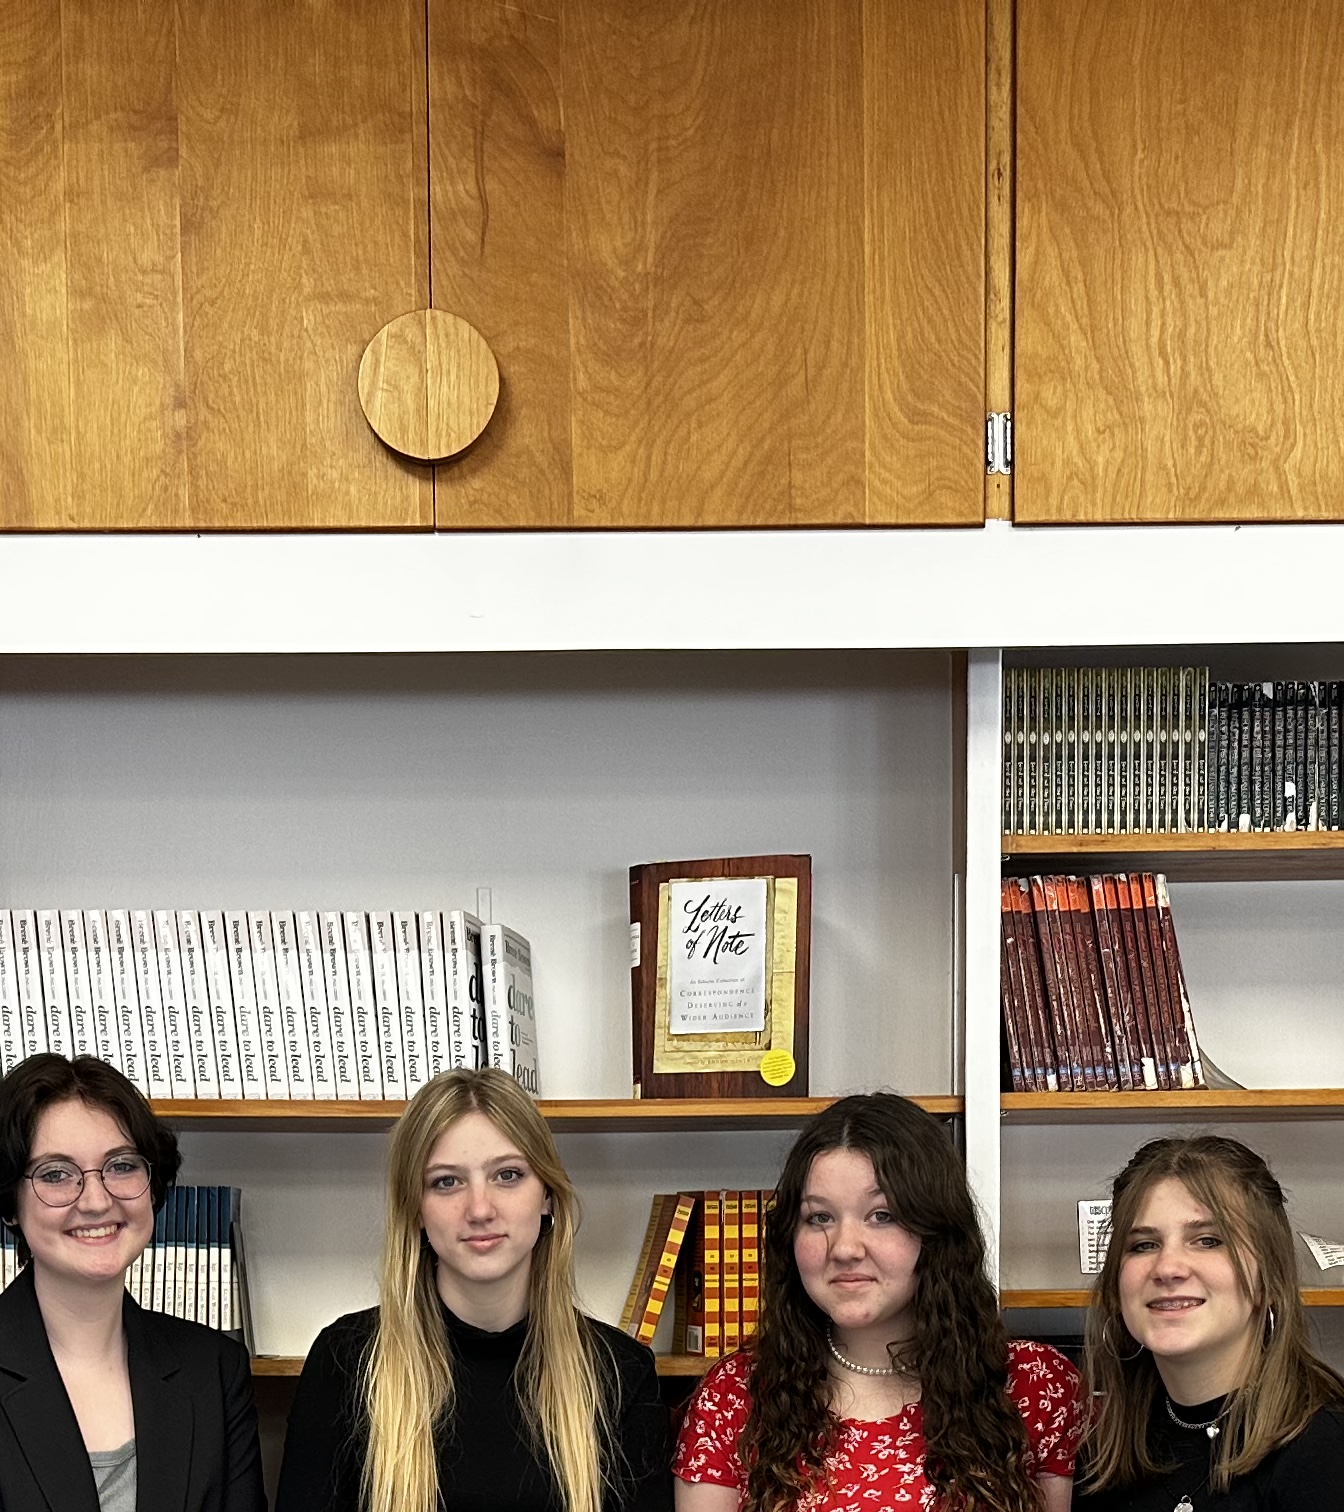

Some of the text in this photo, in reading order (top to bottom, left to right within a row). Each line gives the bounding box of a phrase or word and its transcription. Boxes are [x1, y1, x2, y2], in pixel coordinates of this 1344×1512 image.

[683, 895, 745, 933] Letters
[685, 926, 755, 964] of Note
[508, 974, 534, 1021] dare
[509, 1015, 520, 1047] to
[121, 1005, 139, 1083] dare to lead
[145, 1005, 164, 1083] dare to lead
[168, 1005, 187, 1083] dare to lead
[192, 1006, 210, 1082] dare to lead
[263, 1006, 281, 1082] dare to lead
[310, 1006, 327, 1083] dare to lead
[333, 1006, 351, 1083] dare to lead
[382, 1007, 398, 1083] dare to lead
[510, 1048, 539, 1095] lead
